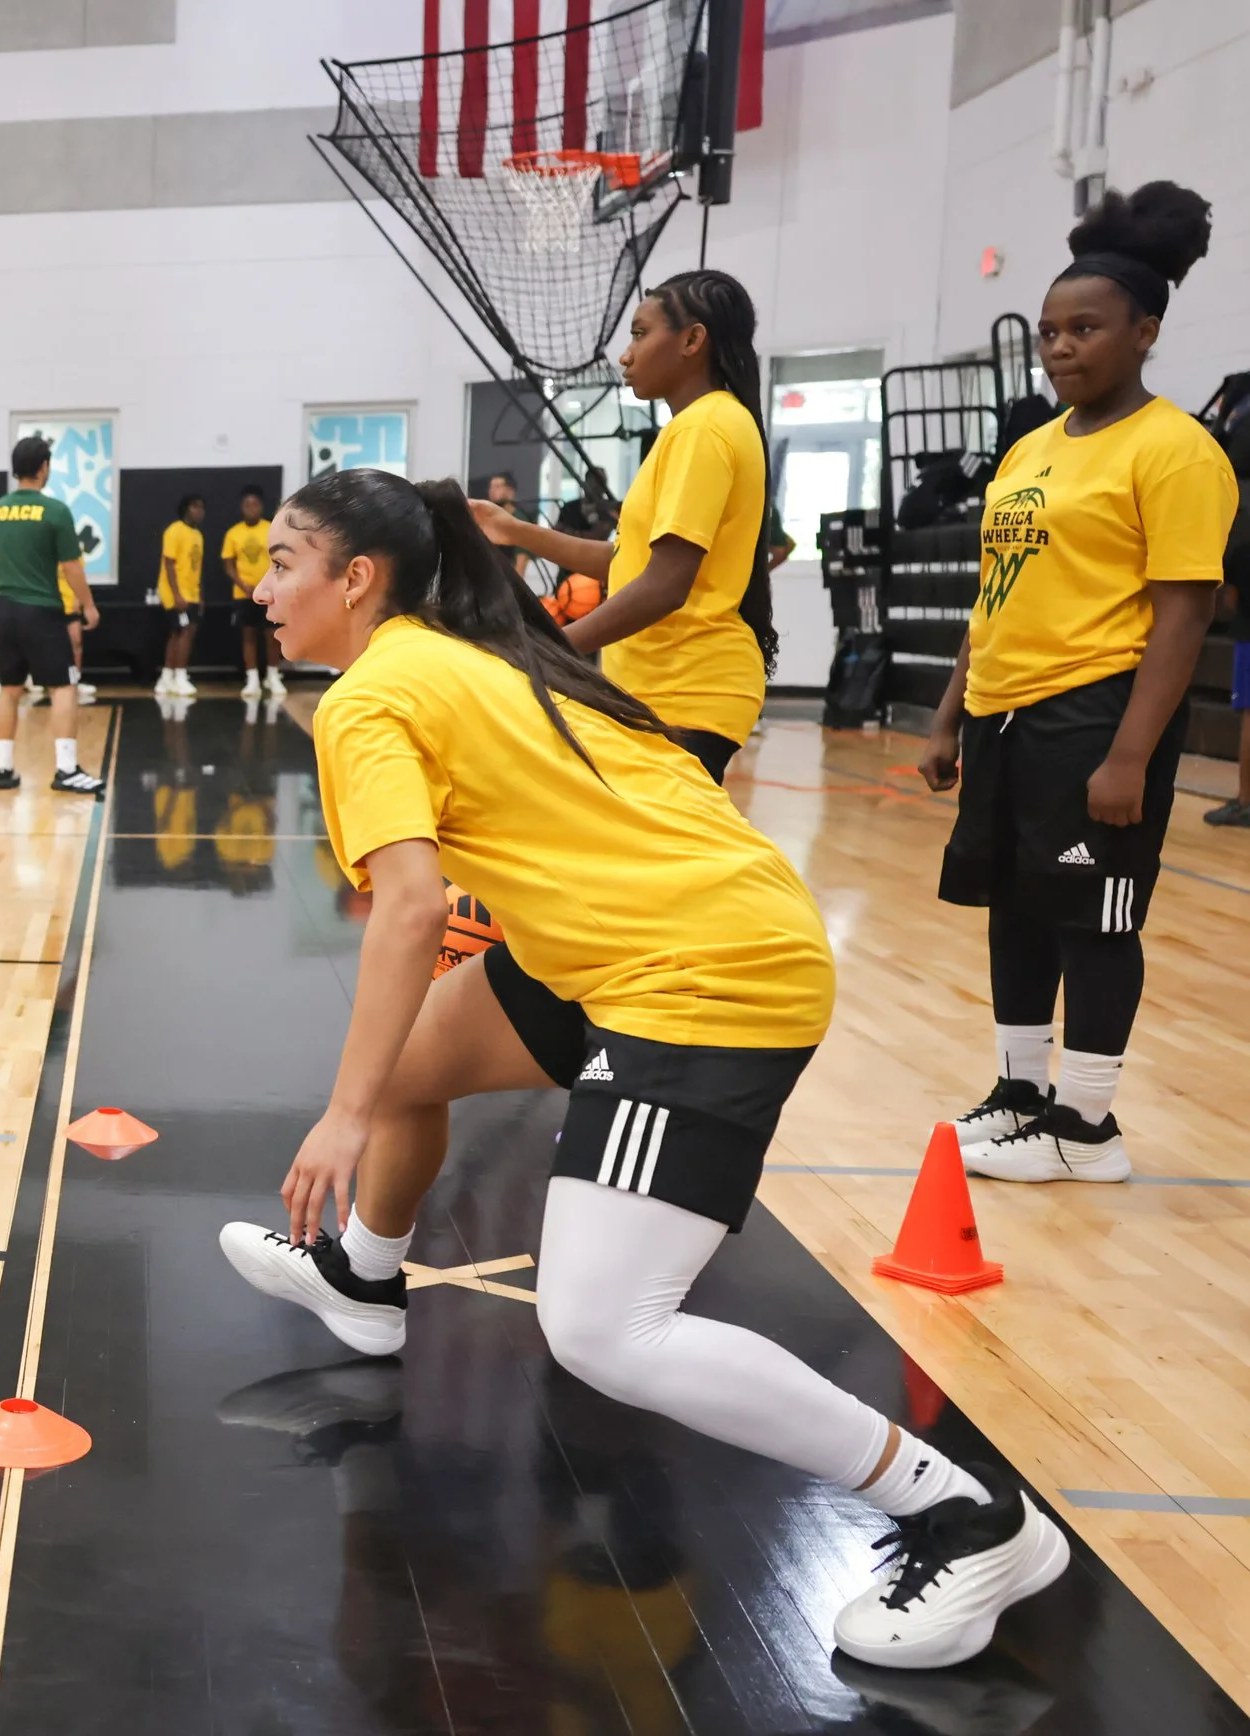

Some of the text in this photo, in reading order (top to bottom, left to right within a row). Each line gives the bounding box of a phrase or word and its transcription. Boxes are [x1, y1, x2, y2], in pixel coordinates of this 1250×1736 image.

[993, 510, 1034, 526] ERICA
[1058, 855, 1095, 865] adidas
[579, 1068, 614, 1081] adidas
